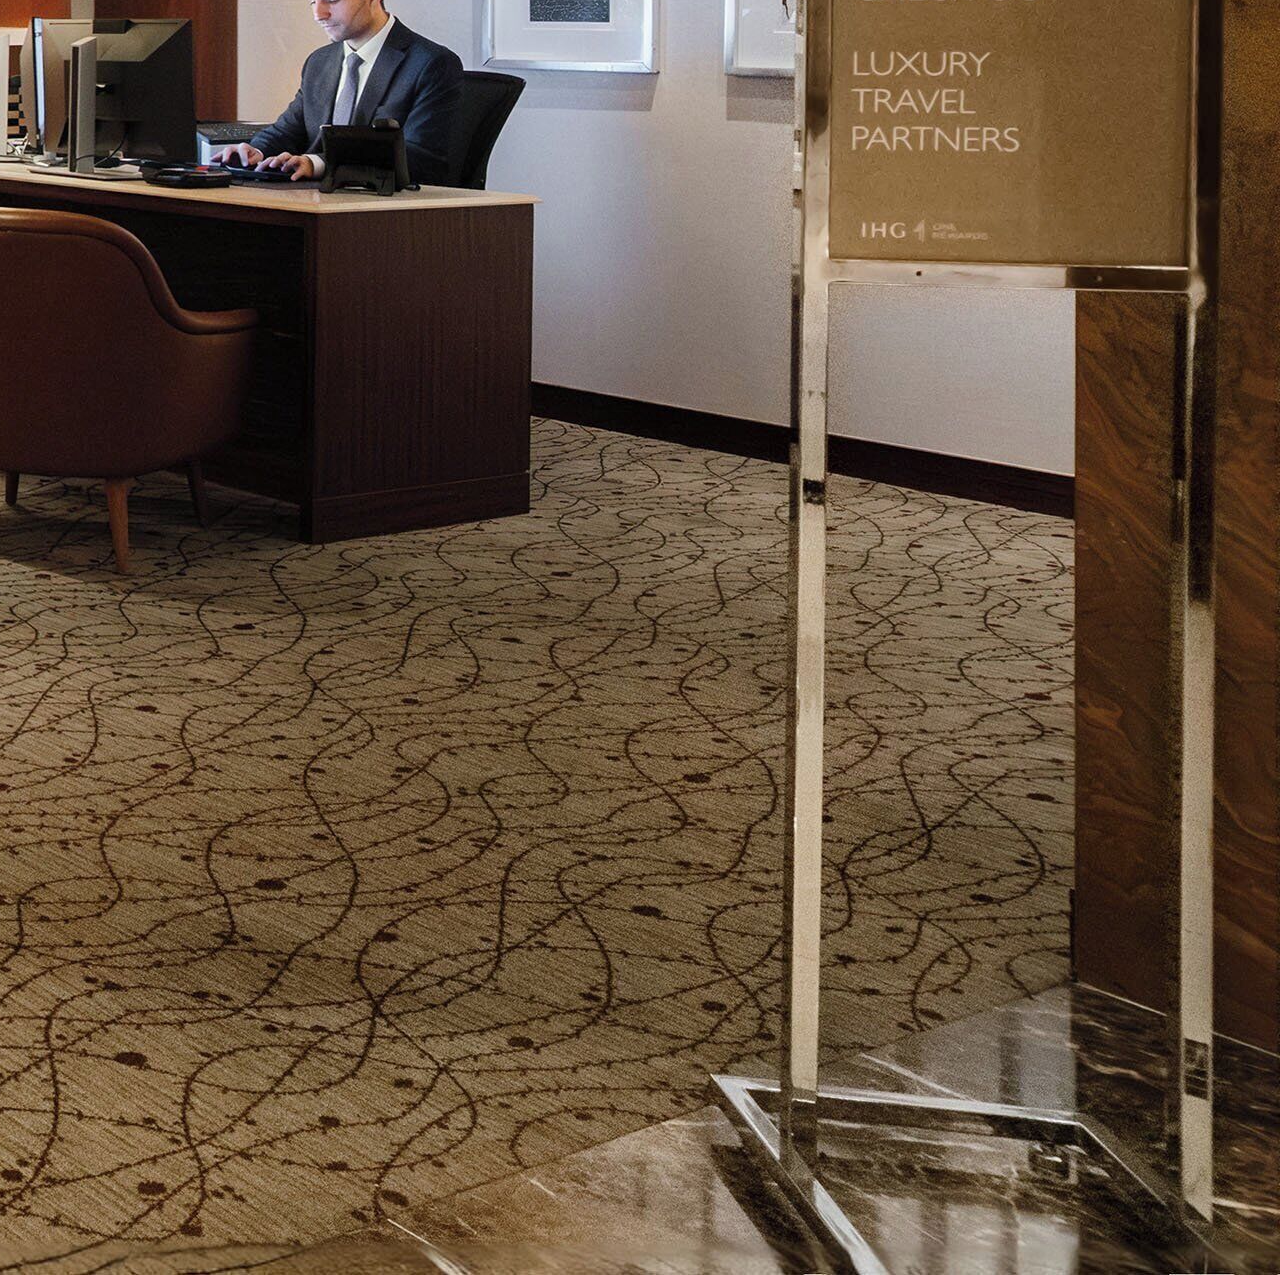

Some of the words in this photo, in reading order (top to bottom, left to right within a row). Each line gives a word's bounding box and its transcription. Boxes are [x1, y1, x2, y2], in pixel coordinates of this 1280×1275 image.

[853, 51, 991, 76] LUXURY
[851, 88, 976, 114] TRAVEL
[851, 126, 1020, 152] PARTNERS
[861, 222, 906, 239] IHG
